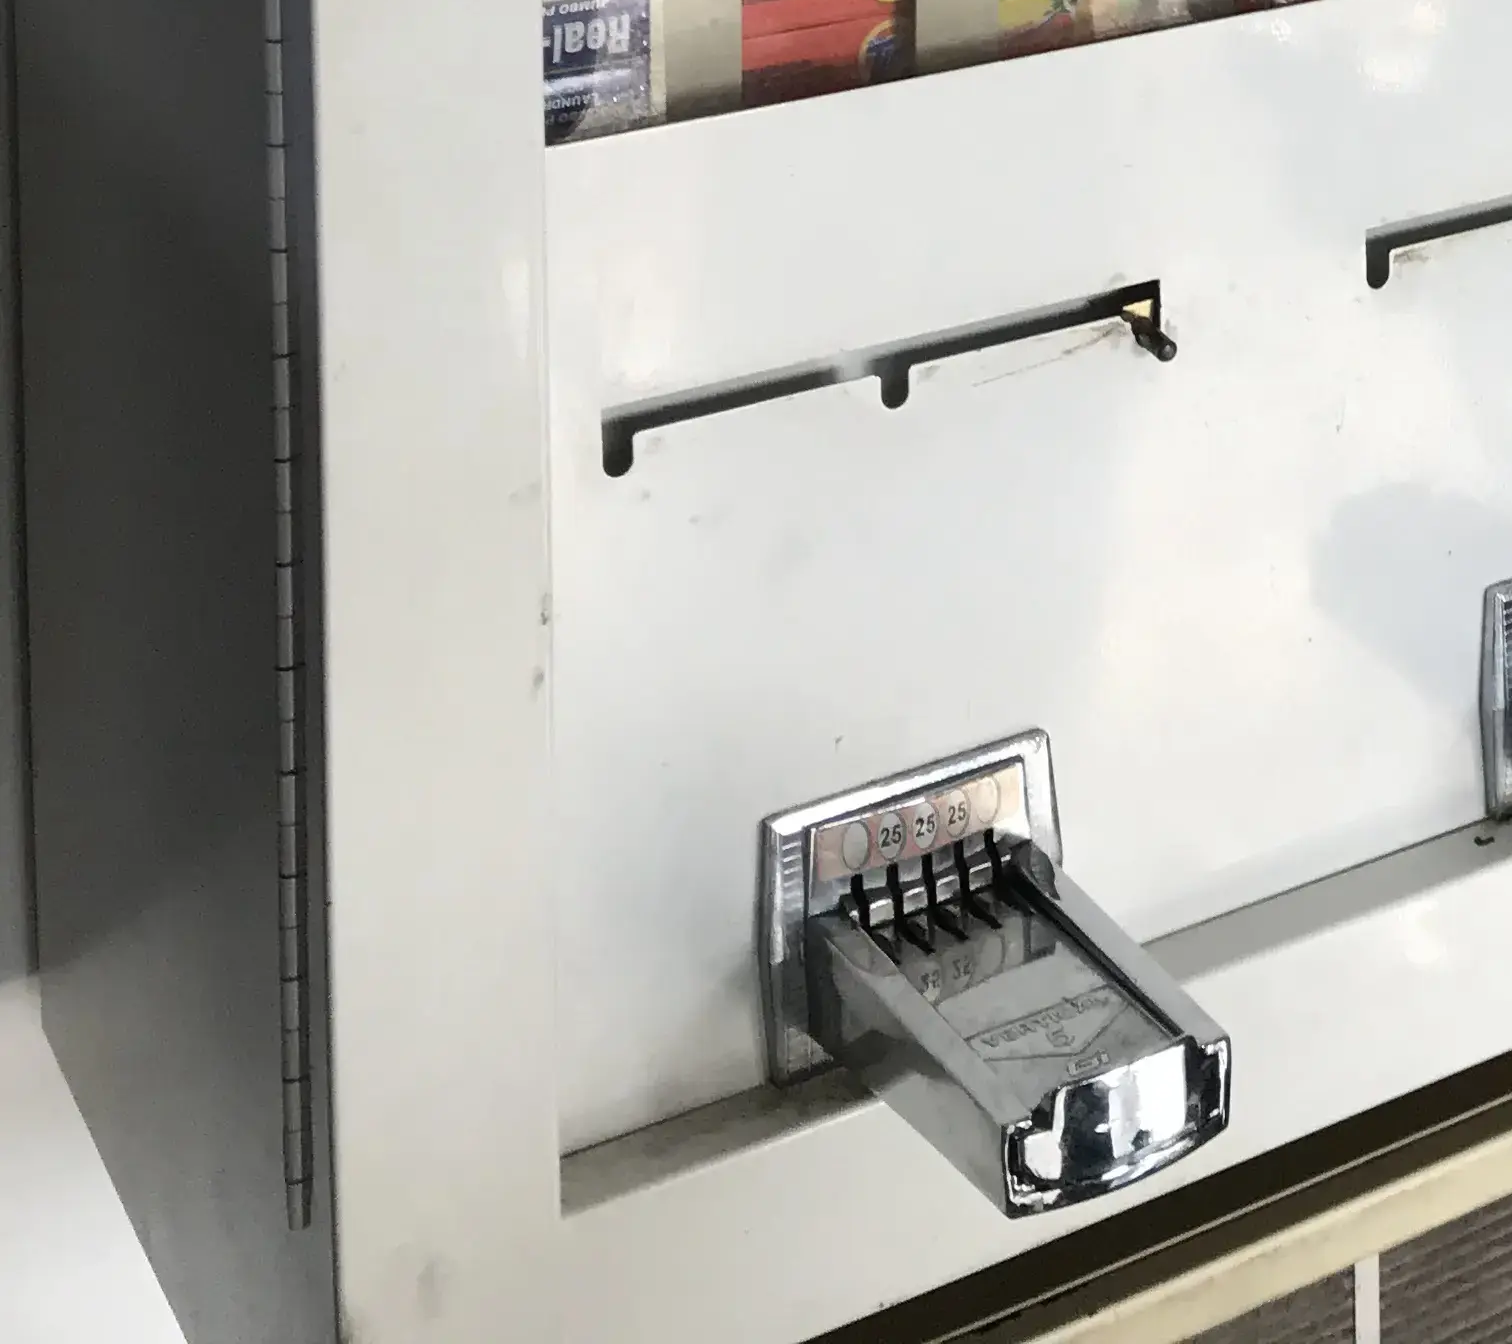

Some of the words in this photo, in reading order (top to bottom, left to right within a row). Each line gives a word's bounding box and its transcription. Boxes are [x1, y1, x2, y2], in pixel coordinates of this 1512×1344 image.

[880, 824, 902, 848] 25
[915, 813, 936, 837] 25
[947, 801, 967, 826] 25
